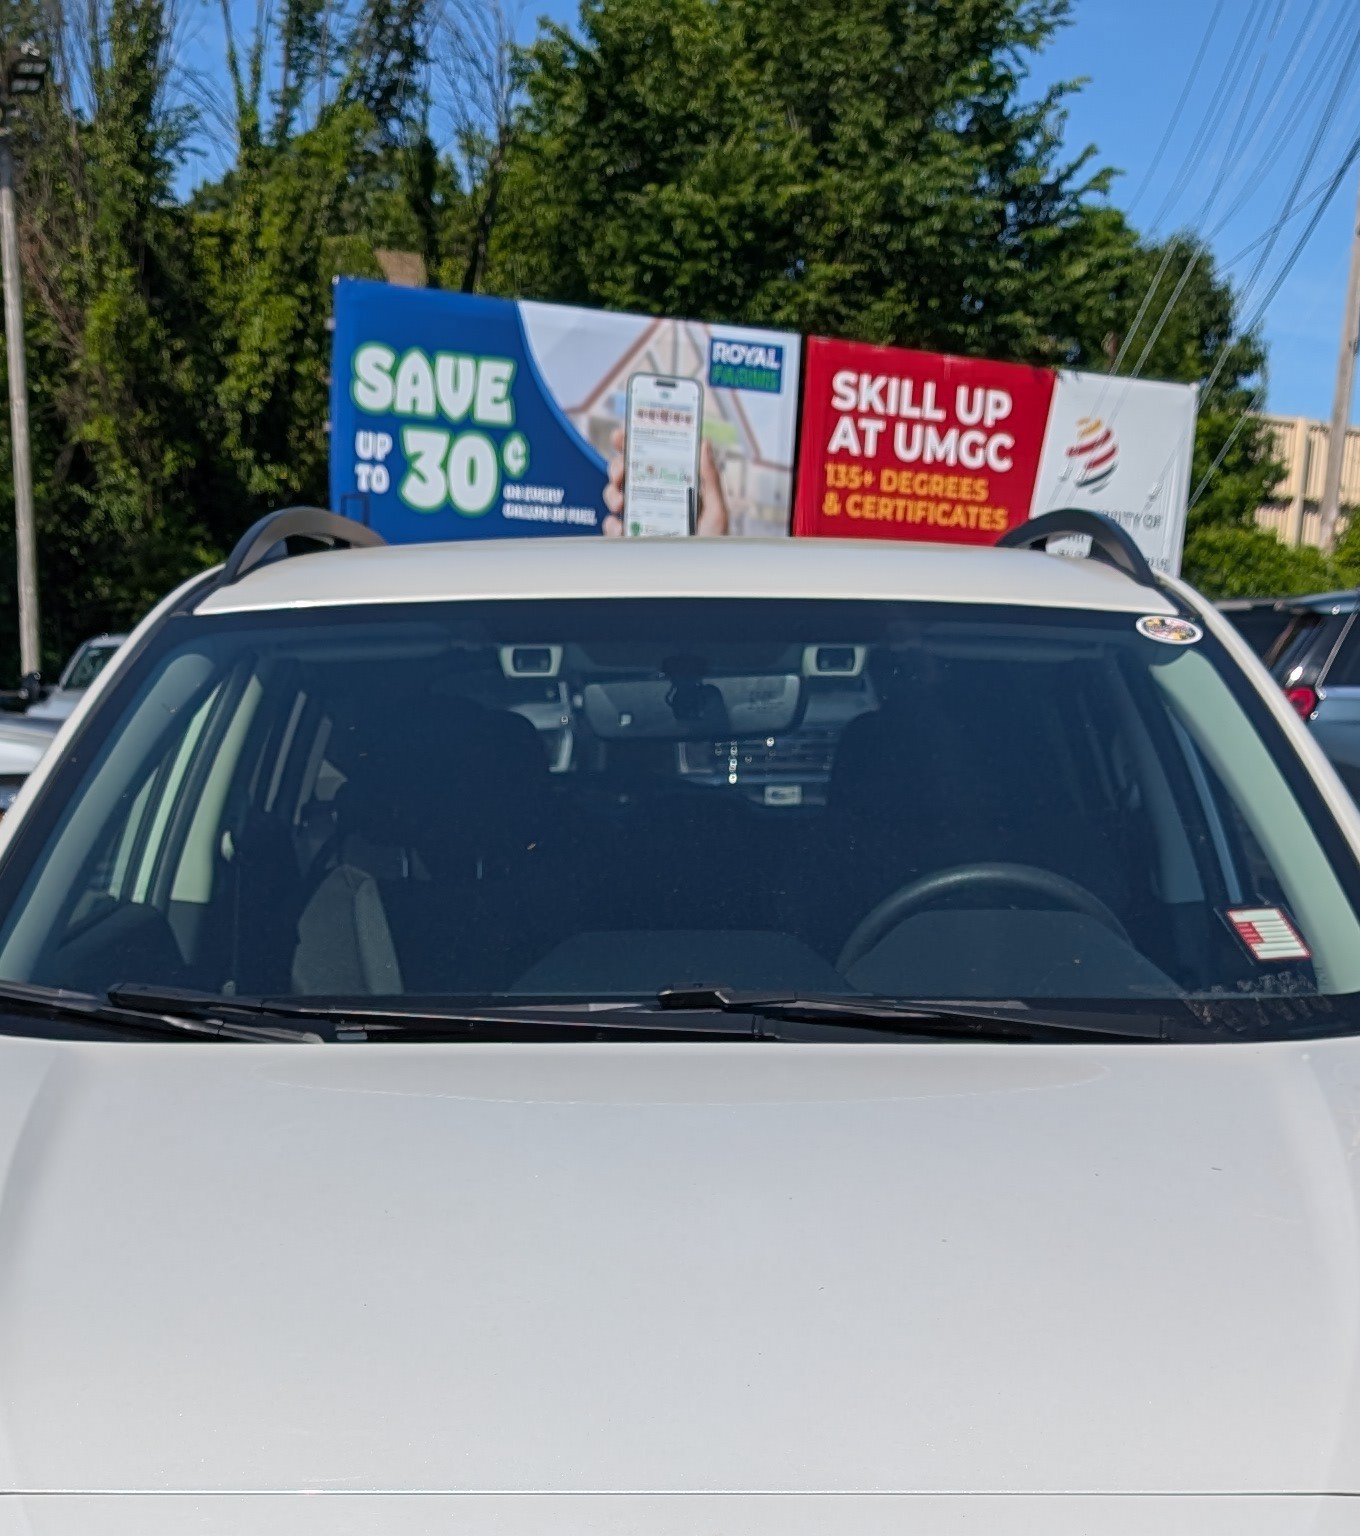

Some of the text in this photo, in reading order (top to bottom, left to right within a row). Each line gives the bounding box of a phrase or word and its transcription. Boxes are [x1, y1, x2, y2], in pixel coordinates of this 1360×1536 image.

[712, 342, 780, 370] ROYAL
[352, 344, 516, 425] SAVE
[831, 370, 1013, 428] SKILL UP
[355, 430, 392, 461] UP
[827, 416, 1015, 472] AT UMGC
[354, 463, 390, 493] TO
[825, 461, 989, 501] 135+ DEGREES
[822, 491, 1009, 531] & CERTIFICATES
